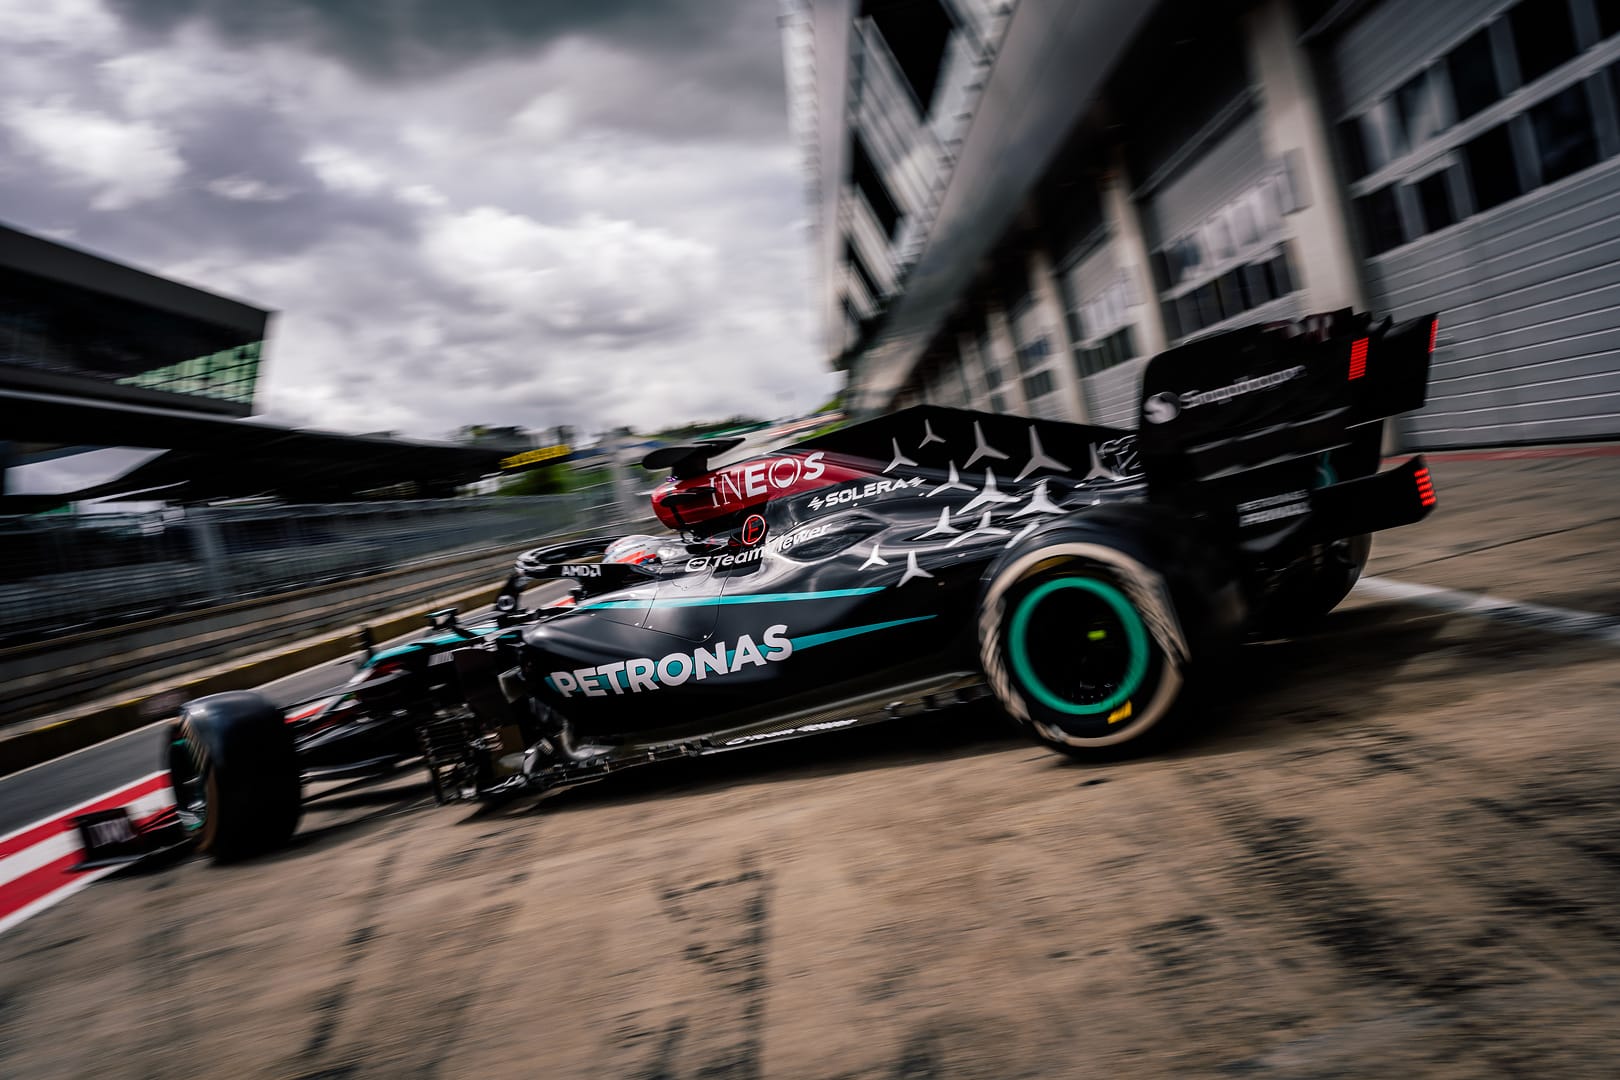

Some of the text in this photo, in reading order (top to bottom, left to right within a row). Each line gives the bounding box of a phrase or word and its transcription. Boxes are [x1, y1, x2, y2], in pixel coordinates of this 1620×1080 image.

[708, 452, 825, 508] INEOS
[824, 477, 909, 508] SOLERA
[711, 523, 832, 569] Teamiewer
[747, 517, 760, 543] E
[561, 565, 590, 577] AMD
[550, 624, 793, 698] PETRONAS
